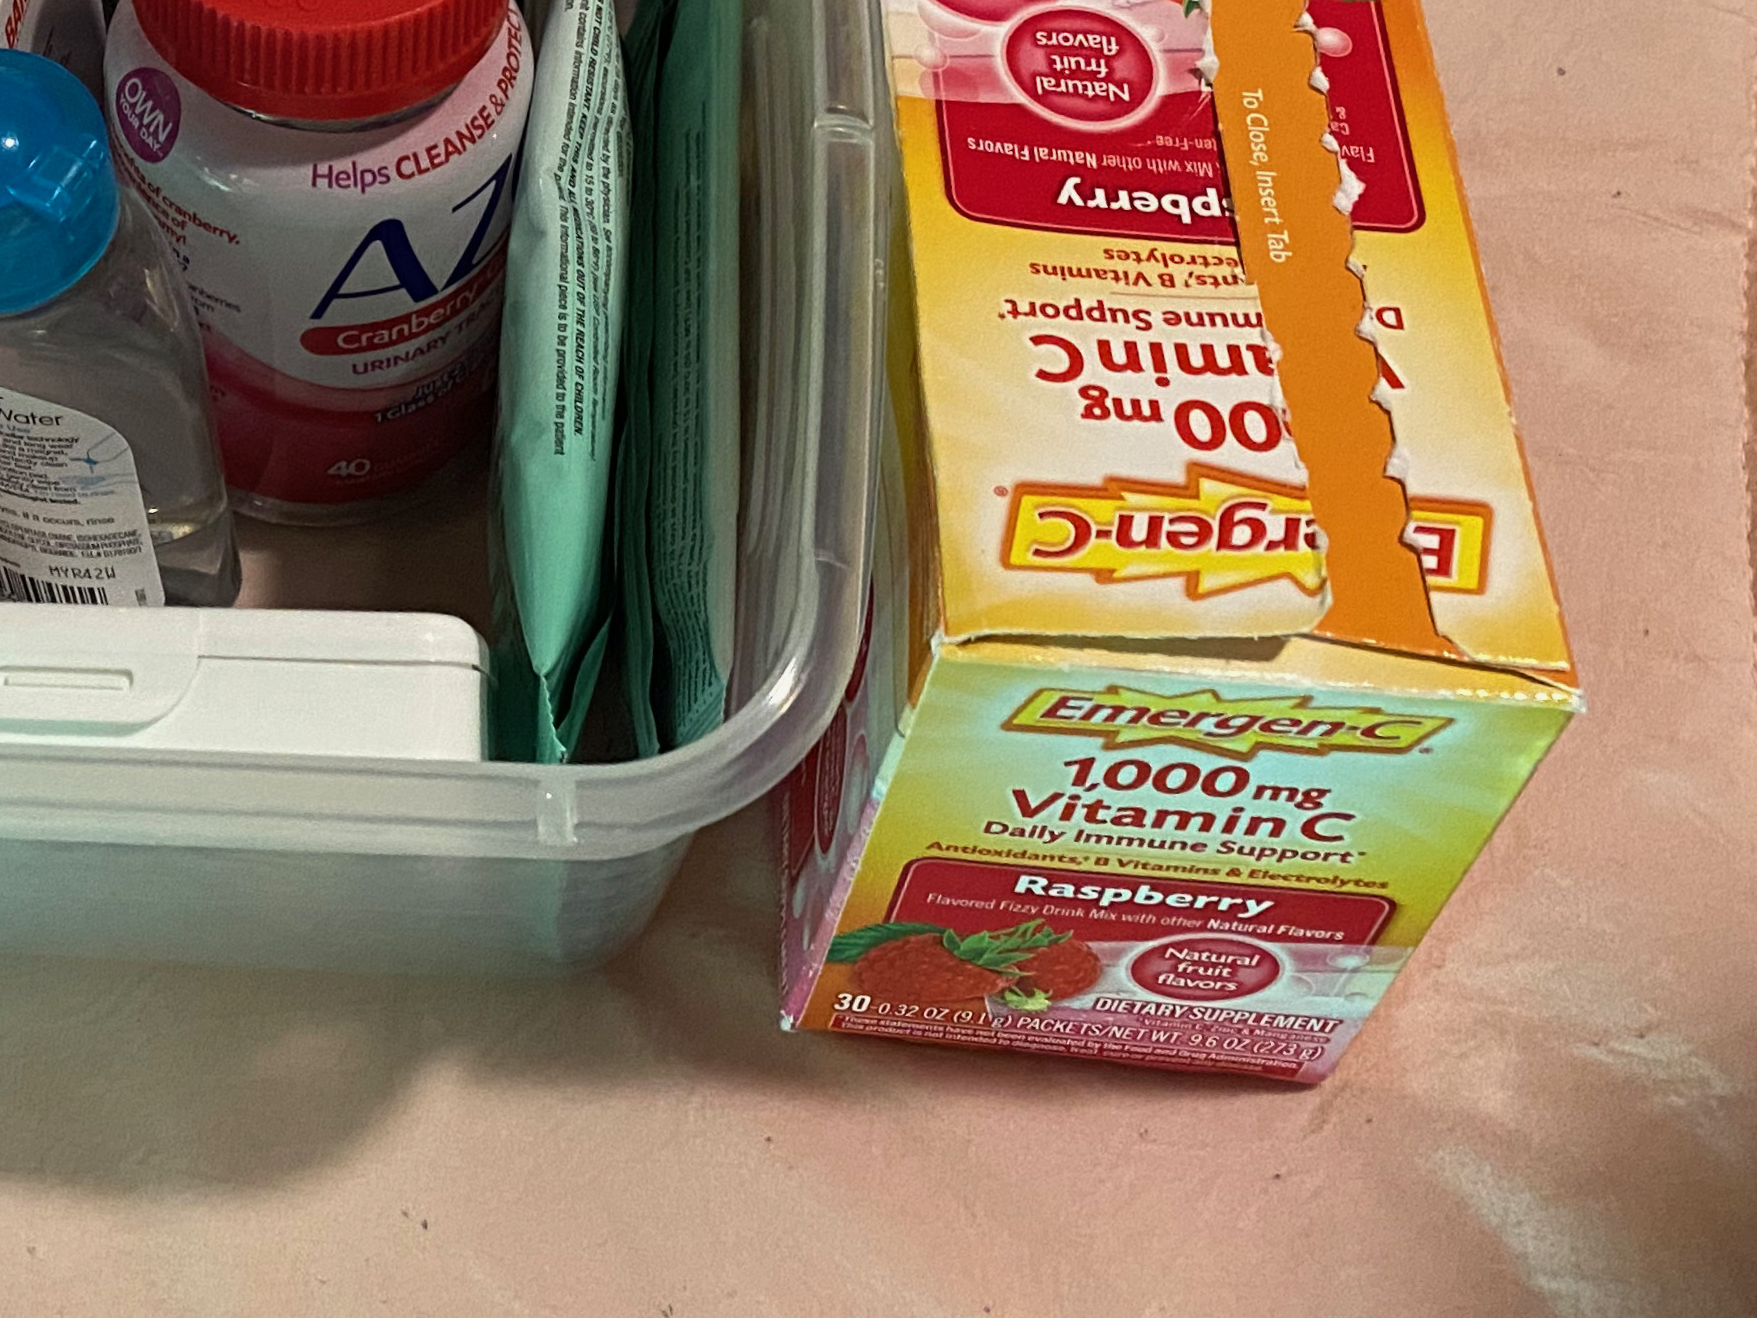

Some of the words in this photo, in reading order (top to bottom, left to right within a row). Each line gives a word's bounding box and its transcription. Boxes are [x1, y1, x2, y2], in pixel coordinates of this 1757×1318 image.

[1035, 28, 1120, 56] flavors
[1051, 53, 1109, 77] fruit
[1035, 75, 1130, 103] Natural
[1242, 87, 1264, 109] To
[124, 77, 173, 144] OWN
[311, 161, 391, 194] Helps
[394, 105, 496, 181] CLEANSE
[489, 93, 506, 116] &
[967, 136, 1030, 162] Flavors
[1245, 112, 1270, 166] Close,
[1034, 146, 1098, 169] Natural
[1100, 154, 1142, 171] other
[1145, 157, 1183, 174] with
[1185, 162, 1214, 178] Mix
[1255, 170, 1284, 225] Insert
[160, 192, 241, 245] cranberry.
[309, 152, 521, 320] AZ
[1266, 229, 1293, 264] Tab
[1029, 262, 1154, 288] Vitamins
[336, 282, 479, 349] Cranberry
[351, 334, 452, 375] URINARY
[574, 328, 586, 365] REACH
[1027, 333, 1084, 384] C
[555, 348, 567, 391] provided
[573, 381, 585, 436] CHILDREN.
[1078, 383, 1164, 424] mg
[554, 420, 565, 456] patient
[326, 458, 371, 477] 40
[1039, 694, 1424, 740] Emergen-C
[1063, 756, 1251, 796] 1,000
[1252, 782, 1332, 812] mg
[1011, 787, 1288, 840] Vitamin
[1299, 811, 1357, 843] C
[982, 819, 1068, 845] Daily
[1073, 827, 1209, 855] Immune
[1092, 857, 1110, 868] B
[1113, 858, 1225, 878] Vitamins
[1226, 867, 1243, 878] &
[1246, 868, 1390, 890] Electrolytes
[1013, 874, 1276, 918] Raspberry
[925, 891, 996, 911] Flavored
[998, 898, 1042, 919] Fizzy
[1041, 903, 1085, 919] Drink
[1087, 908, 1118, 921] Mix
[1118, 910, 1157, 925] with
[1157, 914, 1204, 930] other
[1206, 918, 1271, 936] Natural
[1272, 923, 1346, 942] Flavors
[1164, 947, 1261, 967] Natural
[1176, 961, 1232, 977] fruit
[1157, 973, 1238, 992] flavors
[1095, 997, 1190, 1018] DIETARY
[1189, 1007, 1341, 1033] SUPPLEMENT
[922, 1006, 950, 1022] OZ
[1017, 1015, 1150, 1041] PACKETS/NET
[1188, 1032, 1219, 1048] 9.6
[1222, 1037, 1251, 1051] OZ
[1252, 1038, 1298, 1056] (273
[1298, 1045, 1324, 1062] g)
